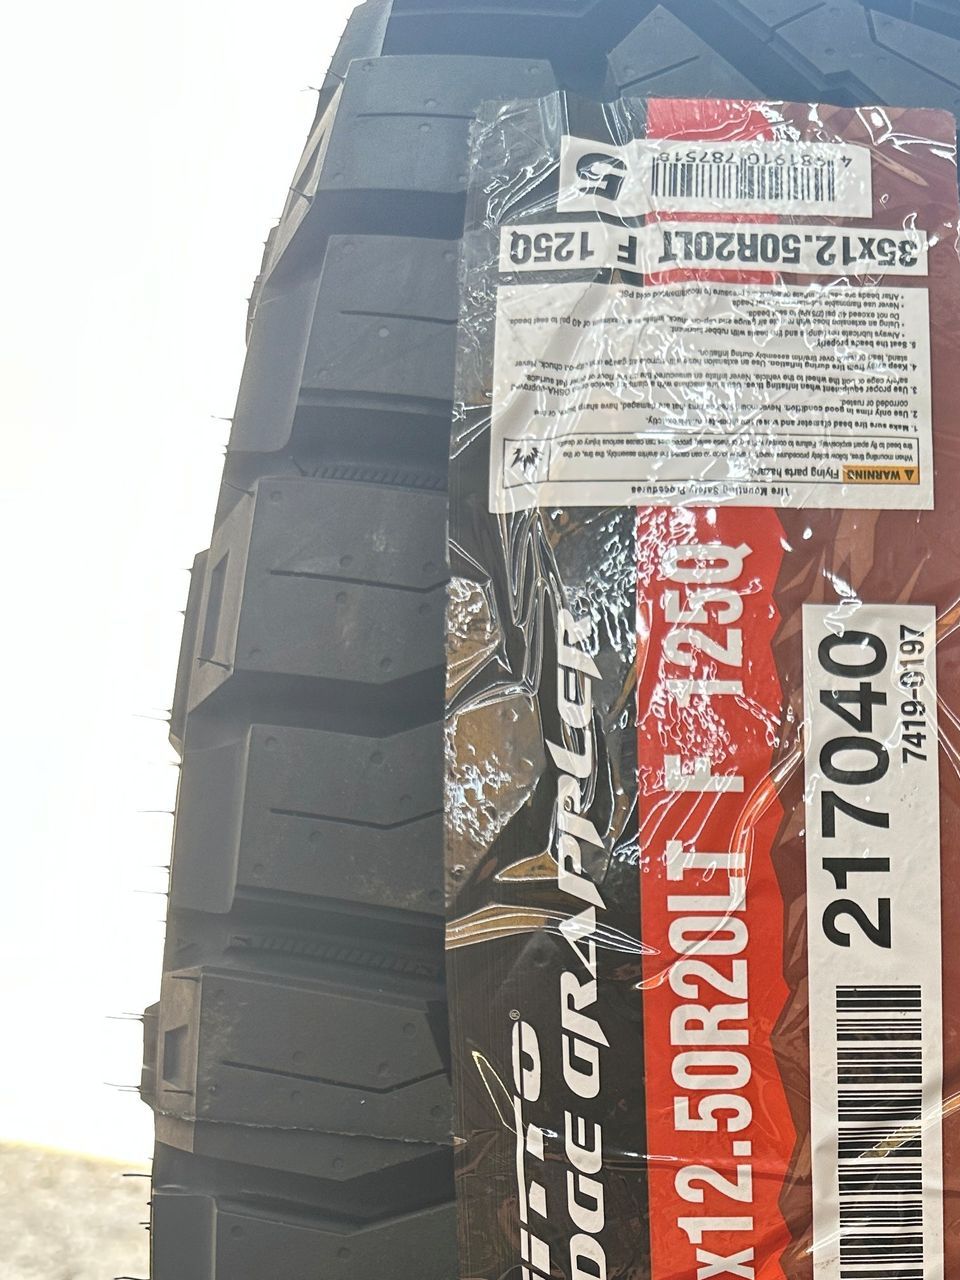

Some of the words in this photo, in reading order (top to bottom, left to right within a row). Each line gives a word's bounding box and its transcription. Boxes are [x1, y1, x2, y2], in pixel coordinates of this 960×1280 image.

[656, 151, 736, 164] 787518
[839, 155, 851, 167] 4
[576, 152, 628, 200] 5
[510, 230, 594, 265] 125Q
[617, 234, 637, 265] F
[658, 230, 919, 268] 35x12.50R20LT
[785, 468, 808, 478] parts
[811, 467, 840, 480] Flying
[846, 470, 901, 480] WARNING
[662, 542, 753, 708] 125Q
[899, 624, 928, 764] 7419-0197
[664, 754, 744, 793] F
[818, 630, 892, 949] 217040
[545, 608, 610, 1099] GRAPPLER
